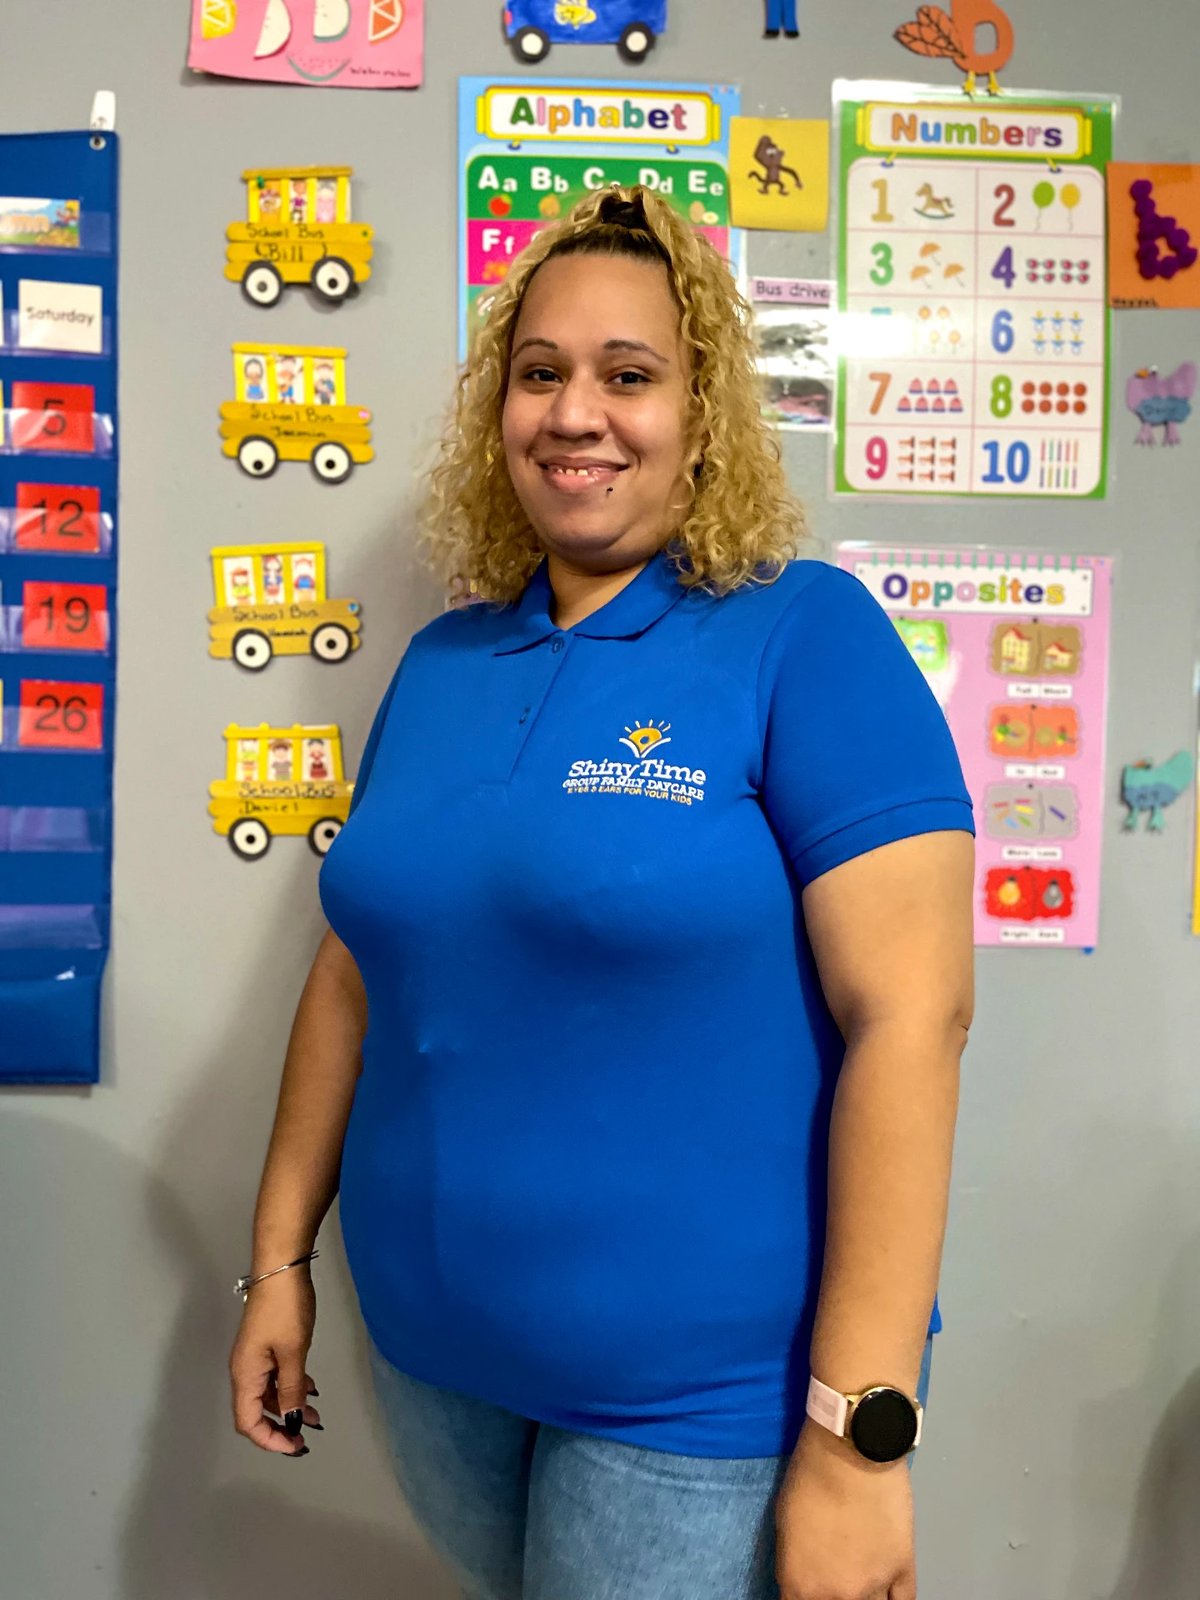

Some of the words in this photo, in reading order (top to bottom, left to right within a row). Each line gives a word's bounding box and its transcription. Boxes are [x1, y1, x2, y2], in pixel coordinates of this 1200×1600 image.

[509, 96, 687, 134] Alphabet
[891, 112, 1063, 148] Numbers
[870, 178, 894, 223] 1
[992, 183, 1016, 227] 2
[298, 223, 325, 238] Bus
[869, 242, 894, 286] 3
[991, 245, 1016, 289] 4
[756, 281, 782, 296] Bus
[26, 306, 95, 327] Saturday
[991, 309, 1015, 354] 6
[868, 372, 892, 416] 7
[989, 374, 1013, 419] 8
[42, 397, 67, 436] 5
[865, 436, 889, 481] 9
[981, 440, 1031, 484] 10
[32, 498, 84, 537] 12
[882, 573, 1065, 607] Opposites
[40, 596, 91, 633] 19
[33, 693, 88, 733] 26
[568, 758, 640, 778] Shiny
[639, 759, 707, 785] Time
[600, 776, 645, 788] FAMILY
[646, 779, 705, 801] DAYCARE
[623, 787, 643, 796] FOR
[644, 788, 670, 800] YOUR
[670, 793, 692, 806] KIDS
